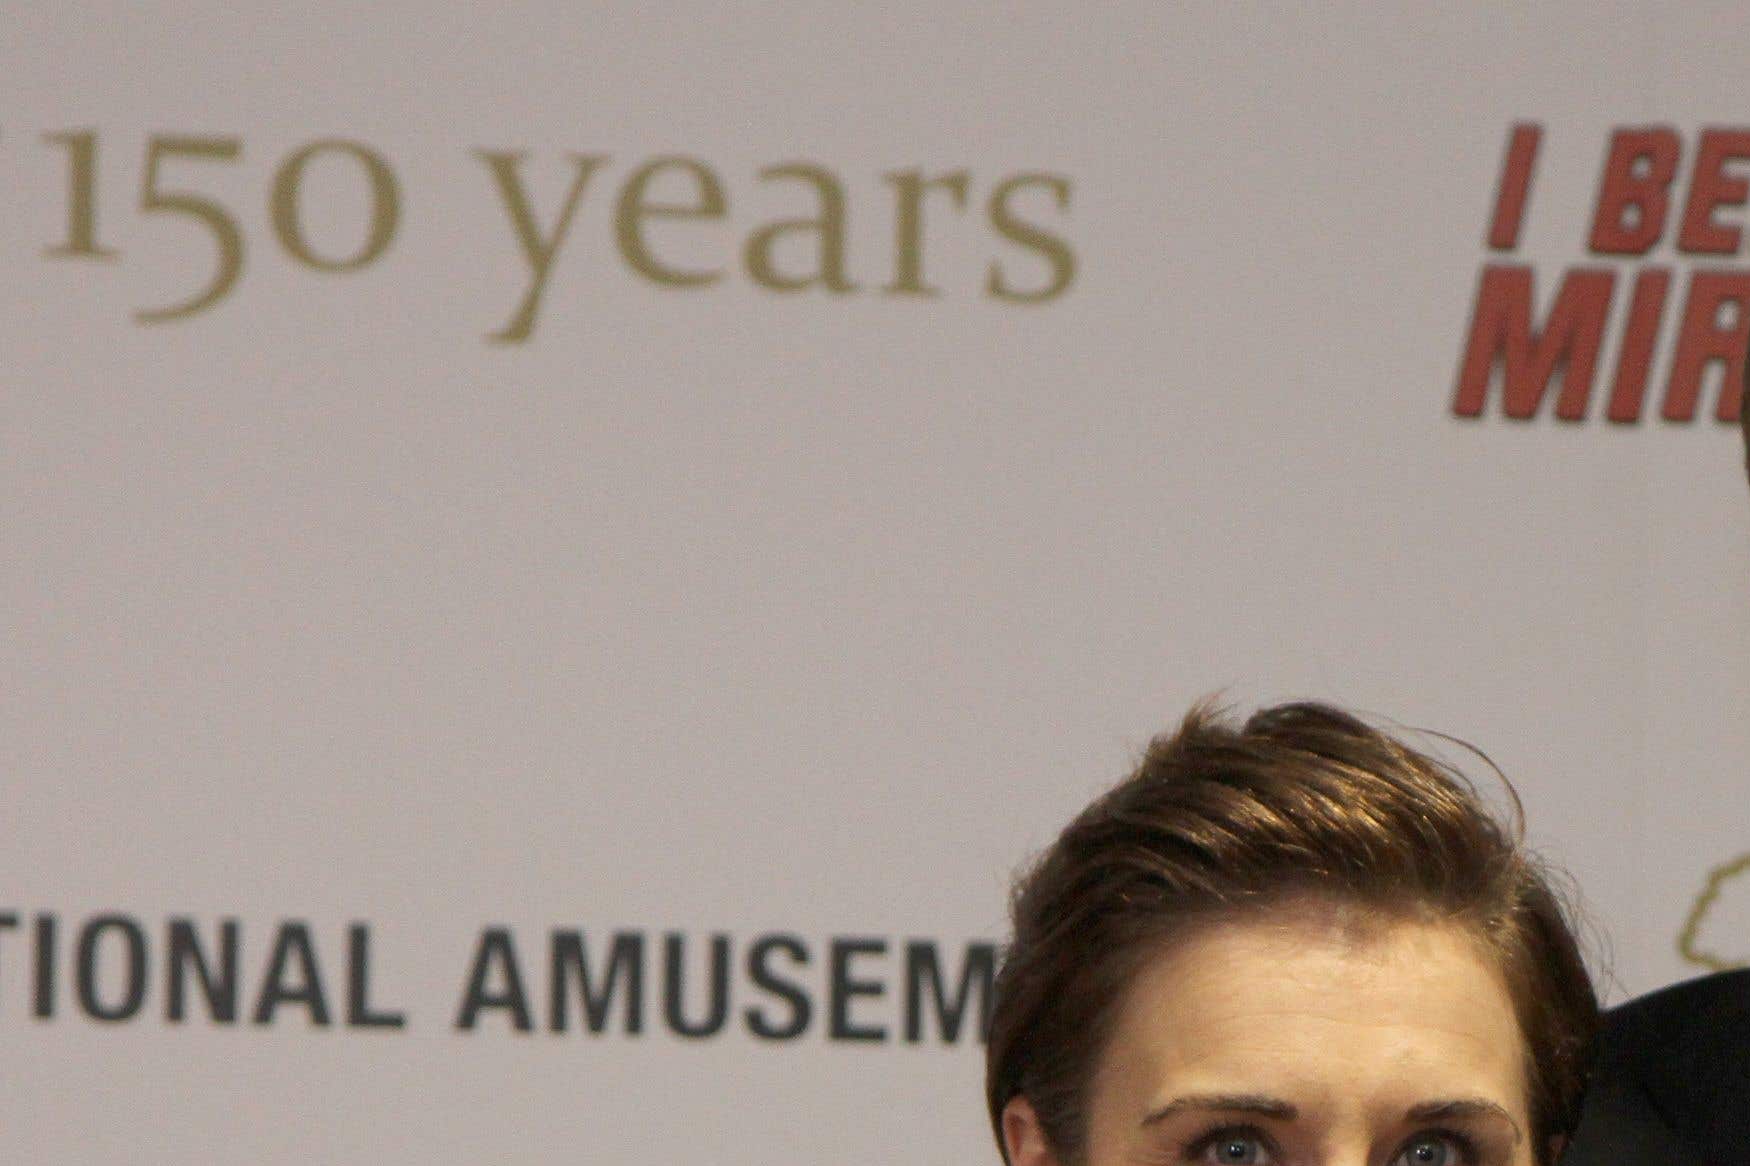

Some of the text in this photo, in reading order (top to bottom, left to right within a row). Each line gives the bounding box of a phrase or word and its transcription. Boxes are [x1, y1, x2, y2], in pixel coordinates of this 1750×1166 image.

[40, 128, 1079, 346] 150 years
[1486, 123, 1543, 254] I
[455, 926, 995, 1046] AMUSEM
